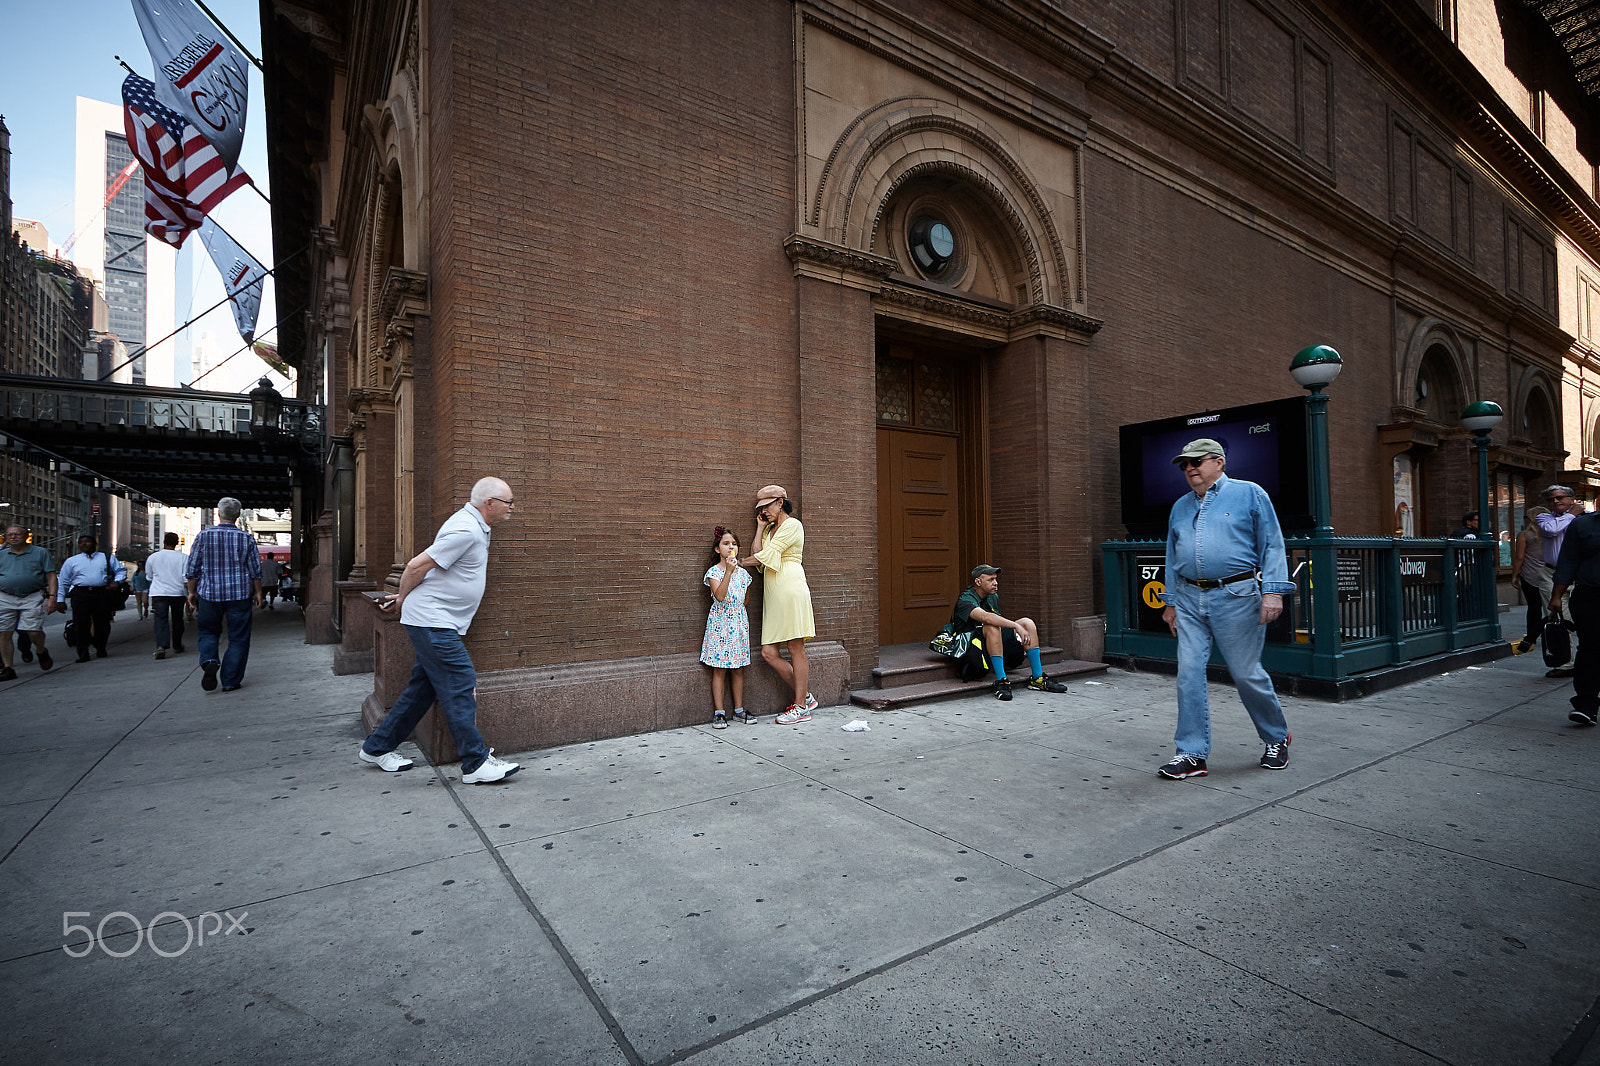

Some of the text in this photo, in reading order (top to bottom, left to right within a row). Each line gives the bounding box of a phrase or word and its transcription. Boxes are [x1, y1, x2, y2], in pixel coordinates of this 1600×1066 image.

[189, 32, 216, 54] HALL
[1248, 422, 1271, 434] nest
[1141, 566, 1160, 580] 57
[1149, 588, 1162, 602] N
